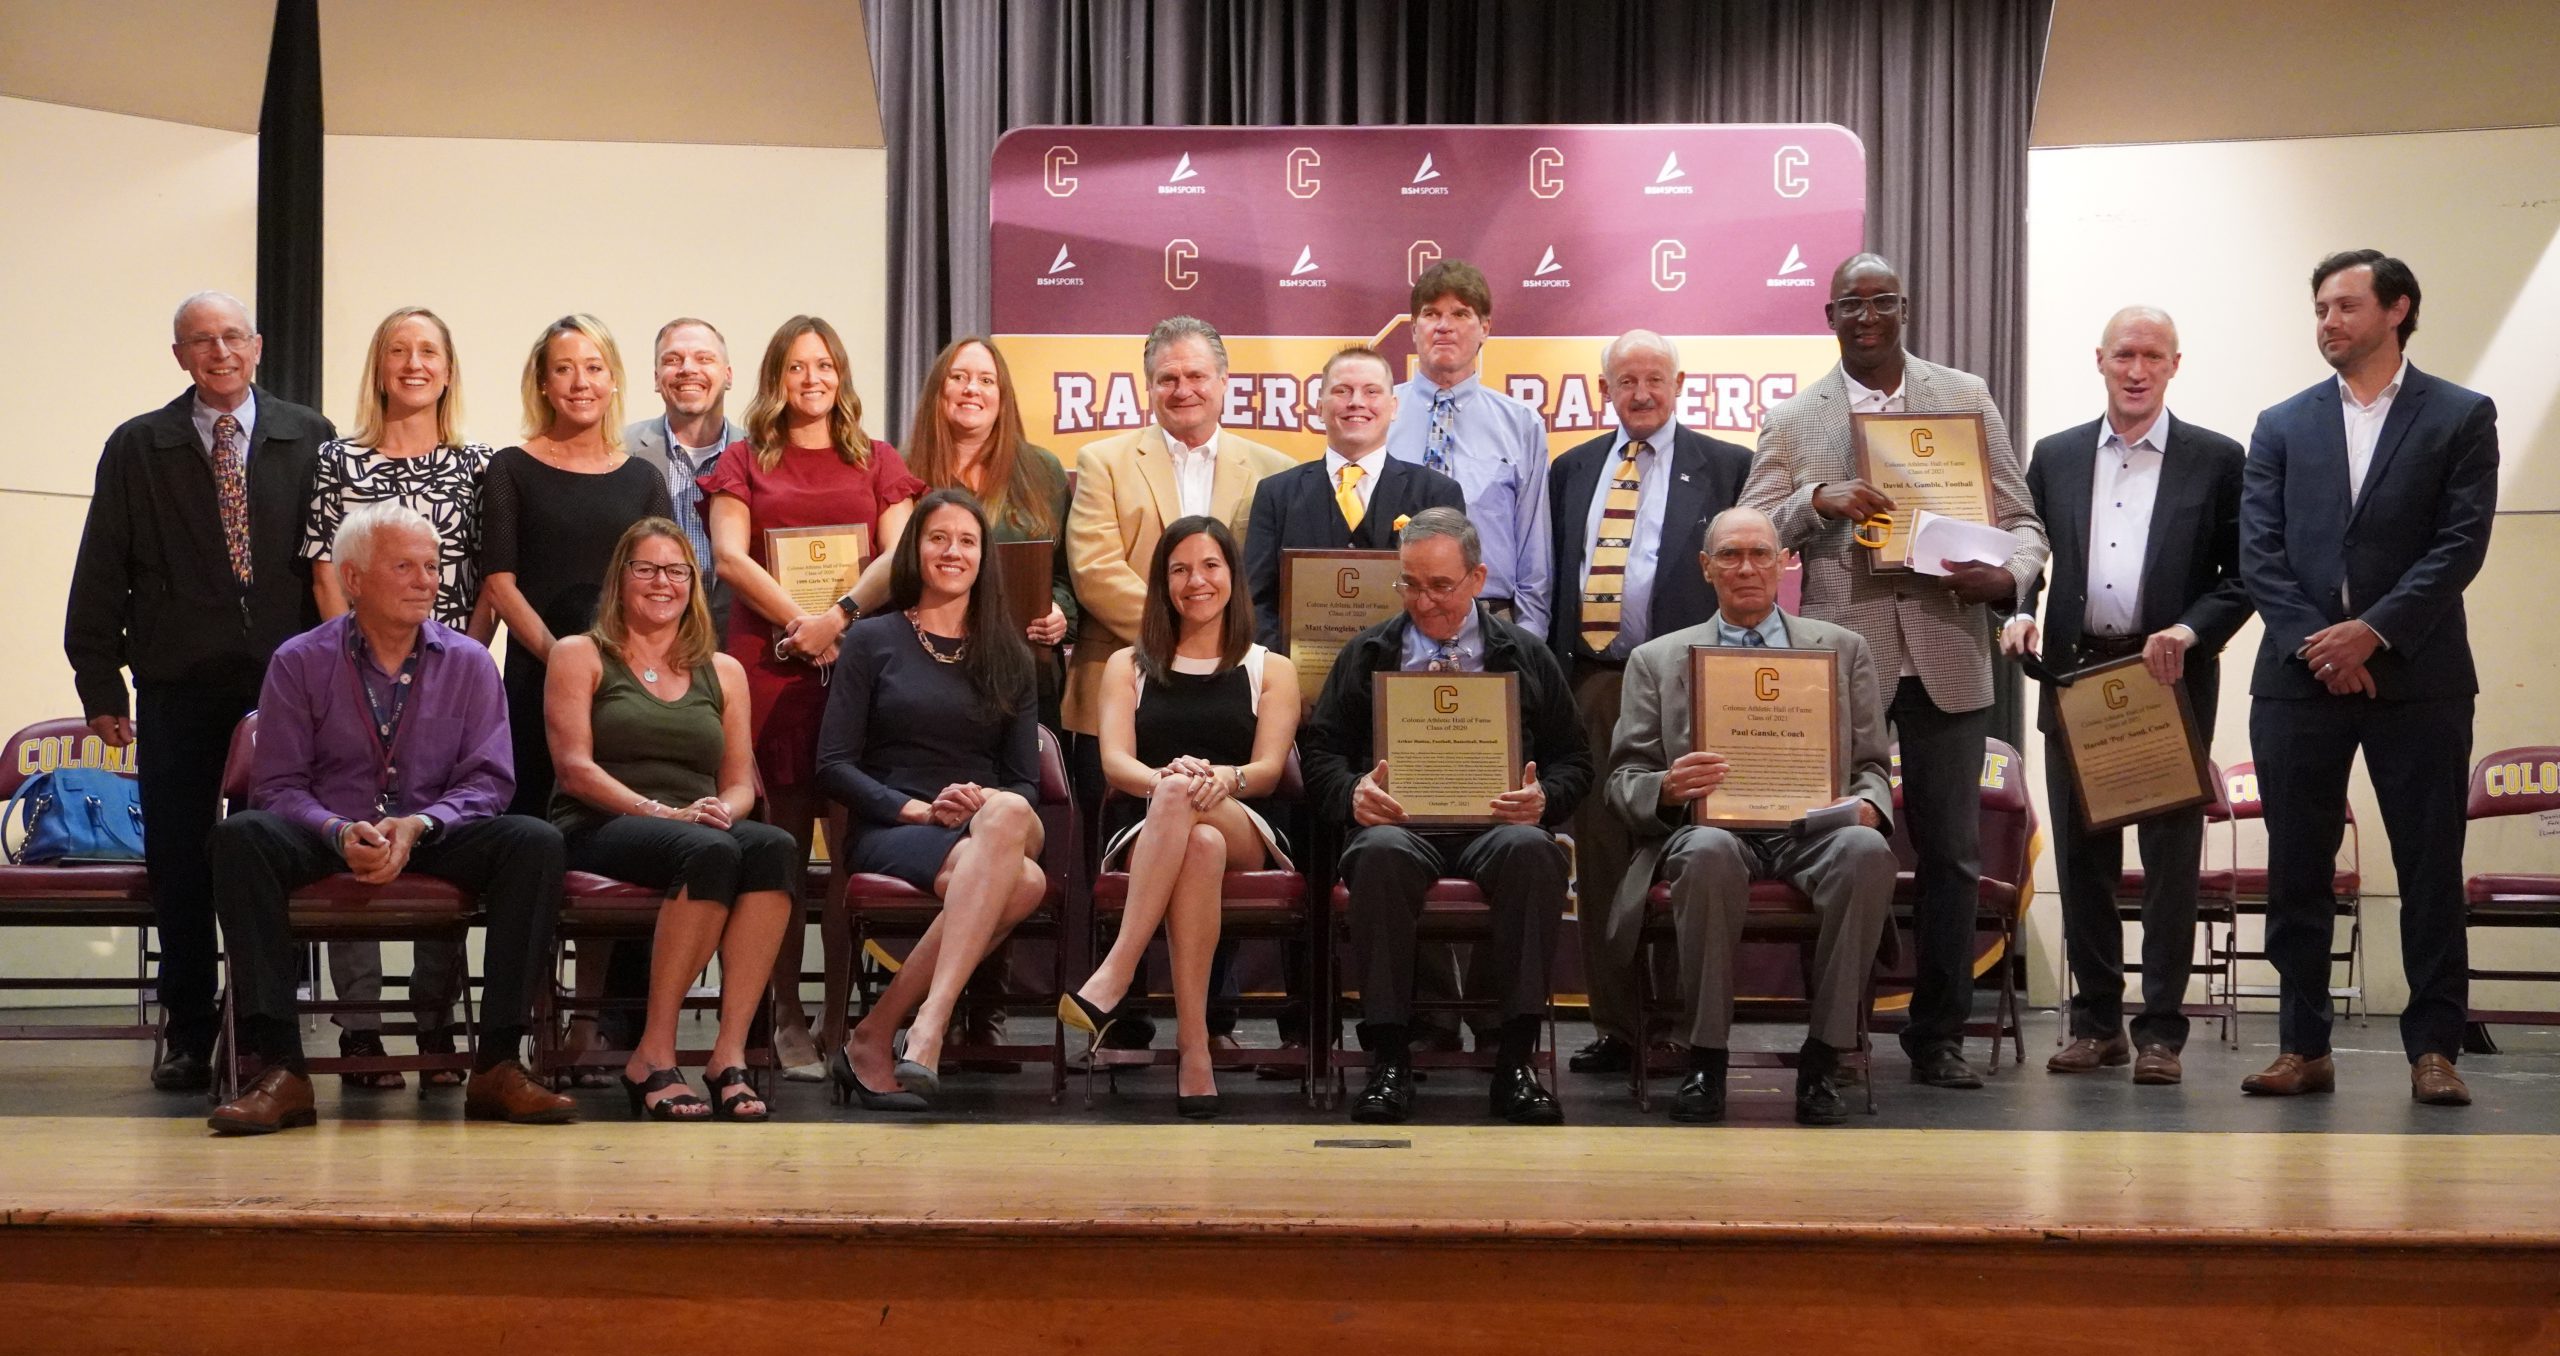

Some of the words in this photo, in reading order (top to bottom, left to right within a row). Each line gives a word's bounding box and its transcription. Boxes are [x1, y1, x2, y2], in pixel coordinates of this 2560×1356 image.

[1044, 145, 1078, 197] C
[1286, 147, 1321, 199] C
[1529, 147, 1564, 198] C
[1773, 145, 1809, 198] C
[1164, 238, 1199, 290] C
[1651, 239, 1687, 292] C
[1910, 428, 1934, 457] C
[809, 540, 826, 562] C
[1337, 568, 1360, 598] C
[1433, 685, 1459, 714] C
[1755, 667, 1779, 701] C
[2102, 678, 2129, 711] C
[1731, 728, 1749, 736] Paul
[1780, 730, 1805, 738] Coach
[18, 735, 138, 776] COLONI
[2484, 761, 2560, 798] COLO
